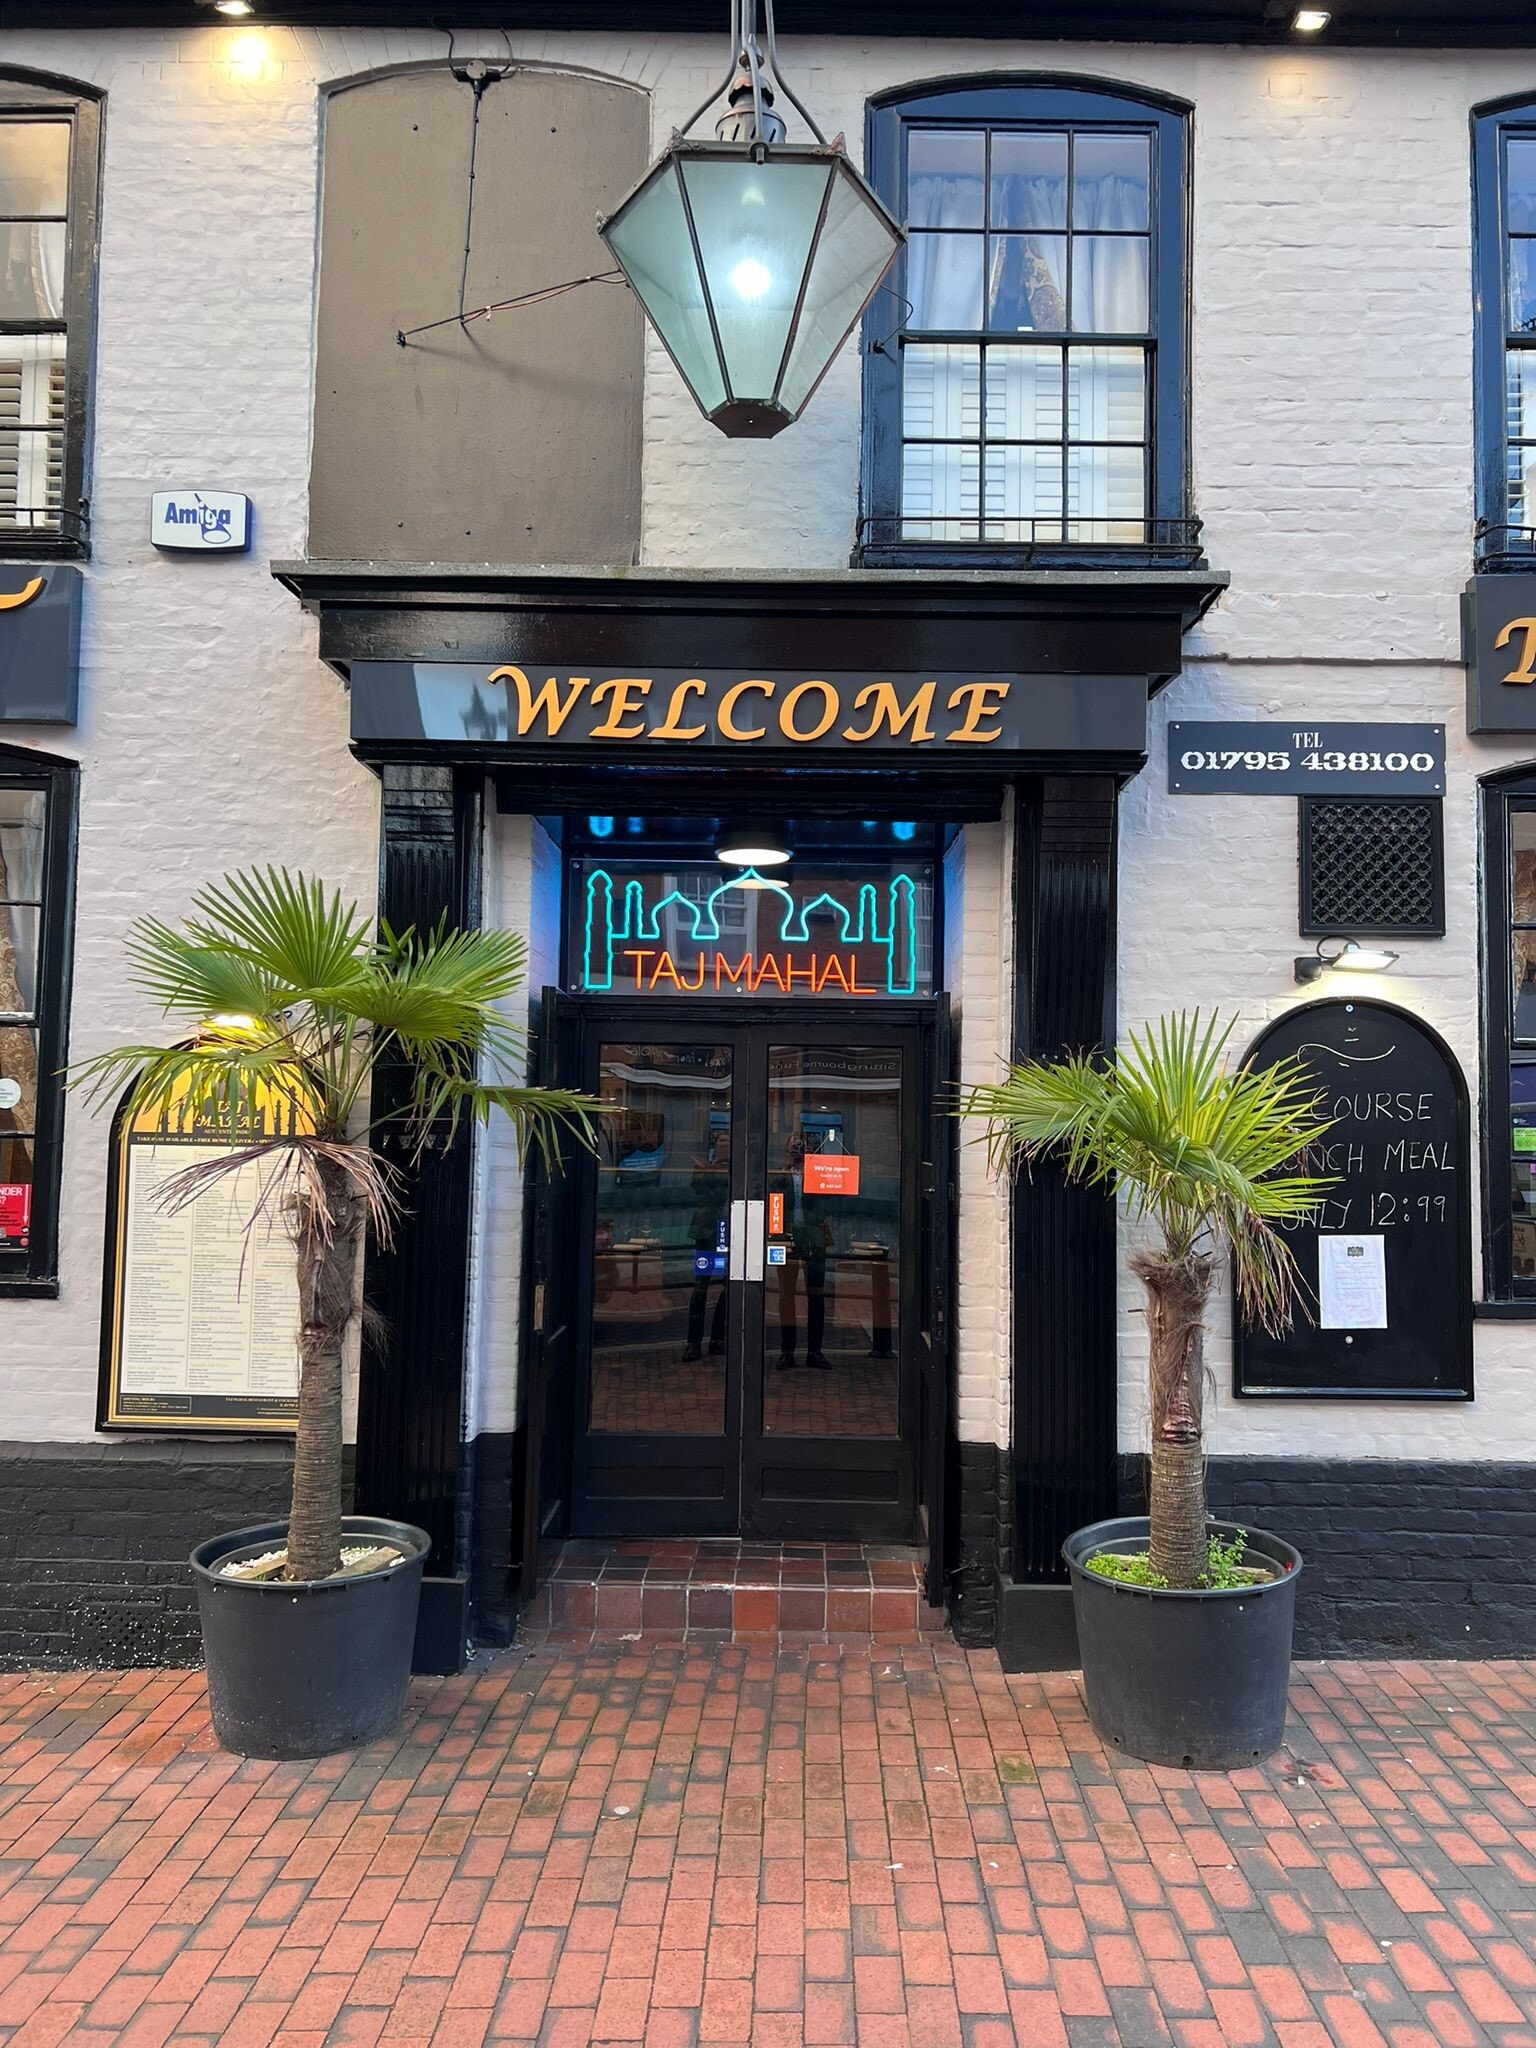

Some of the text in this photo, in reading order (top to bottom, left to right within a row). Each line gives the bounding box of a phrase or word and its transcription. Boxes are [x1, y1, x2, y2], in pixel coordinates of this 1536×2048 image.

[164, 502, 231, 530] Amiga
[487, 665, 1011, 744] WELCOME
[1292, 731, 1323, 749] TEL
[1181, 751, 1435, 772] 01795 438100
[623, 950, 877, 994] TAJ MAHAL
[1311, 1085, 1433, 1122] COURSE
[1384, 1139, 1455, 1173] MEAL
[772, 1195, 780, 1222] PUSH
[1370, 1192, 1446, 1226] 12:99
